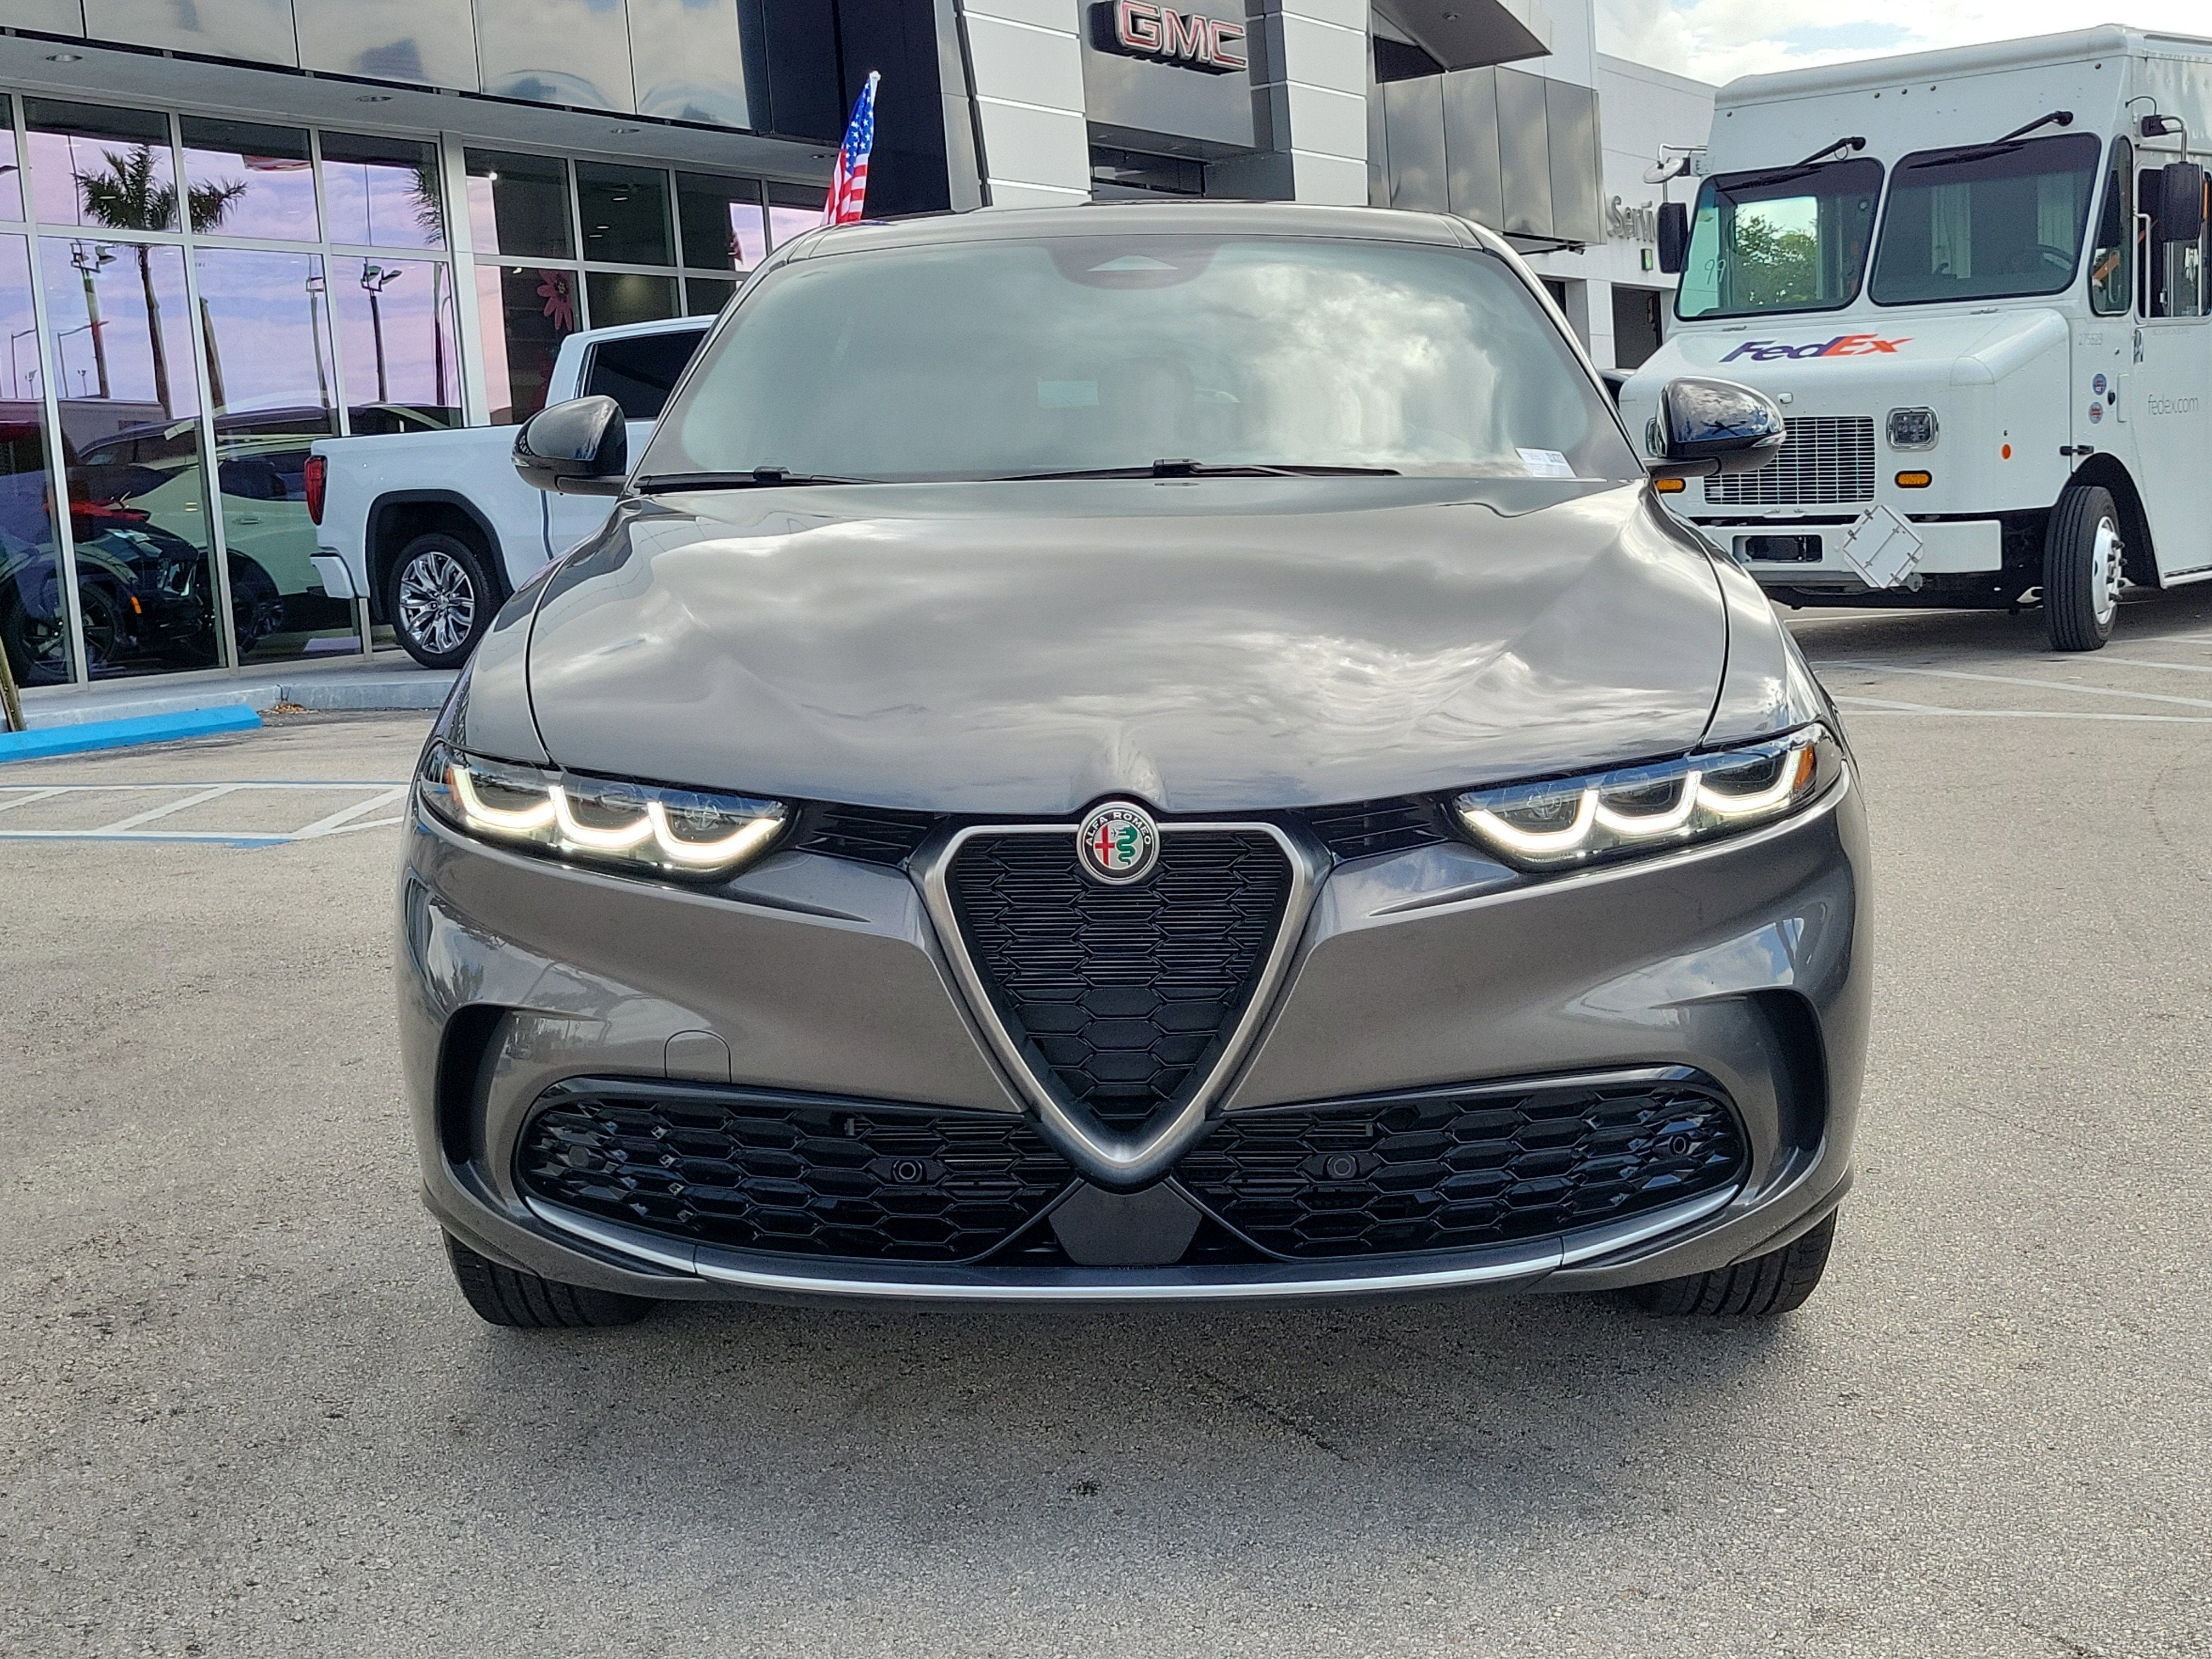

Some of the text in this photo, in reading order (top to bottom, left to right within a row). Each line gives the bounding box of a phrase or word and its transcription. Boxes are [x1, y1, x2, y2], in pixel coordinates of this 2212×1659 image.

[1114, 0, 1248, 71] GMC
[1718, 334, 1915, 363] FedEx
[2148, 393, 2199, 415] fedex.com
[1086, 811, 1152, 847] ALFA ROMEO
